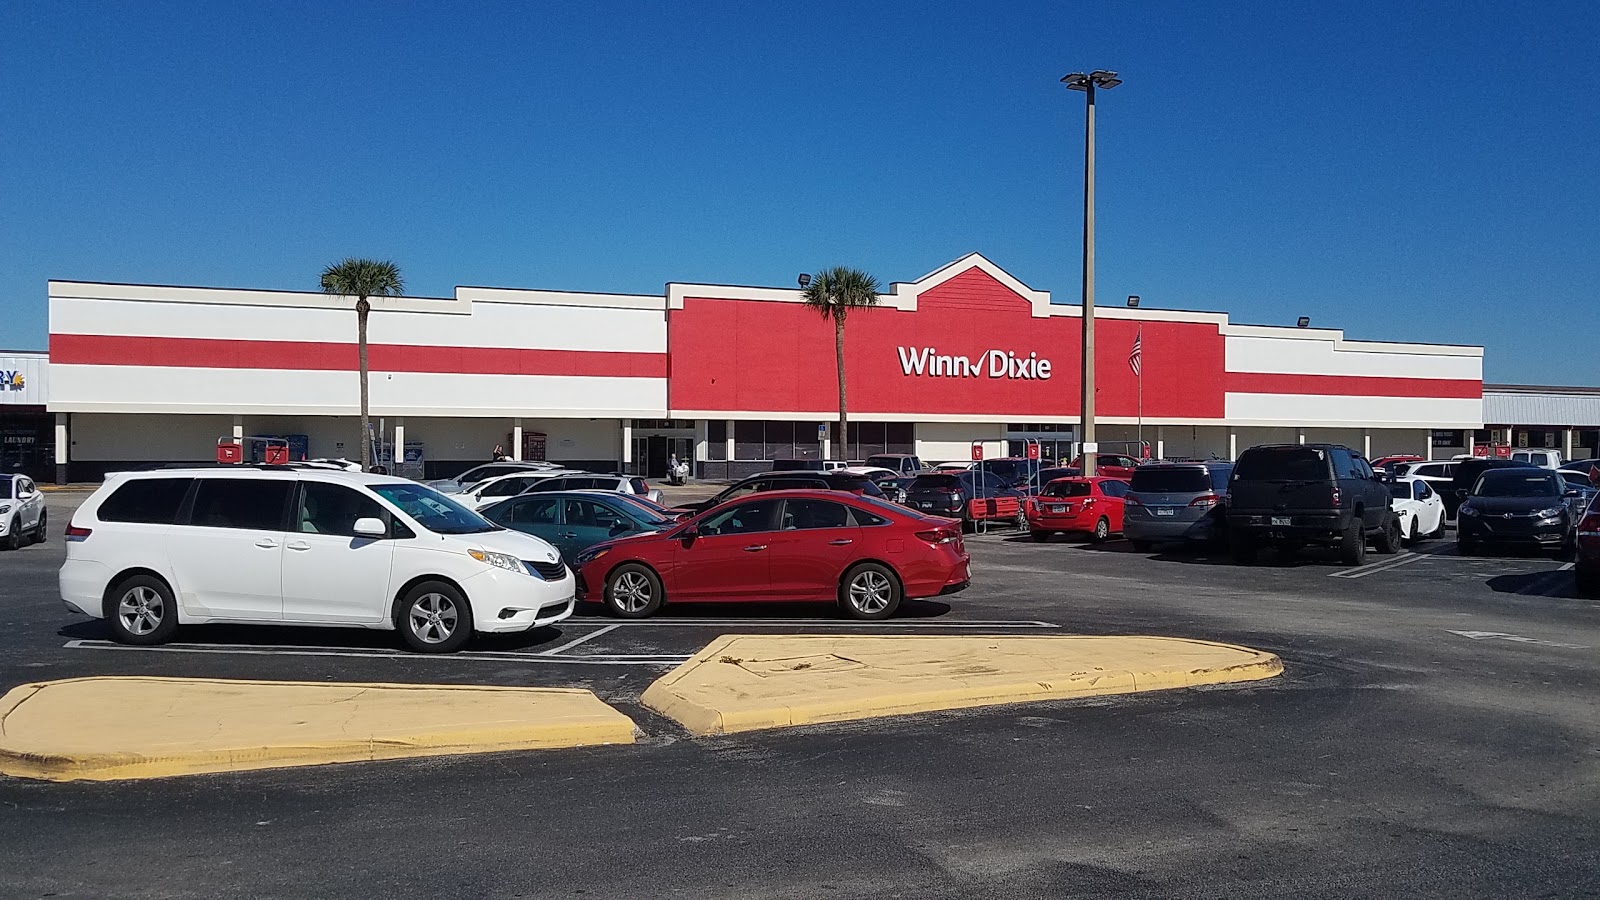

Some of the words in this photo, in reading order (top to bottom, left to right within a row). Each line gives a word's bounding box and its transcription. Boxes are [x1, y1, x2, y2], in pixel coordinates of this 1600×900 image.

[897, 346, 969, 377] Winn
[988, 349, 1052, 379] Dixie
[4, 436, 35, 444] LAUNDRY
